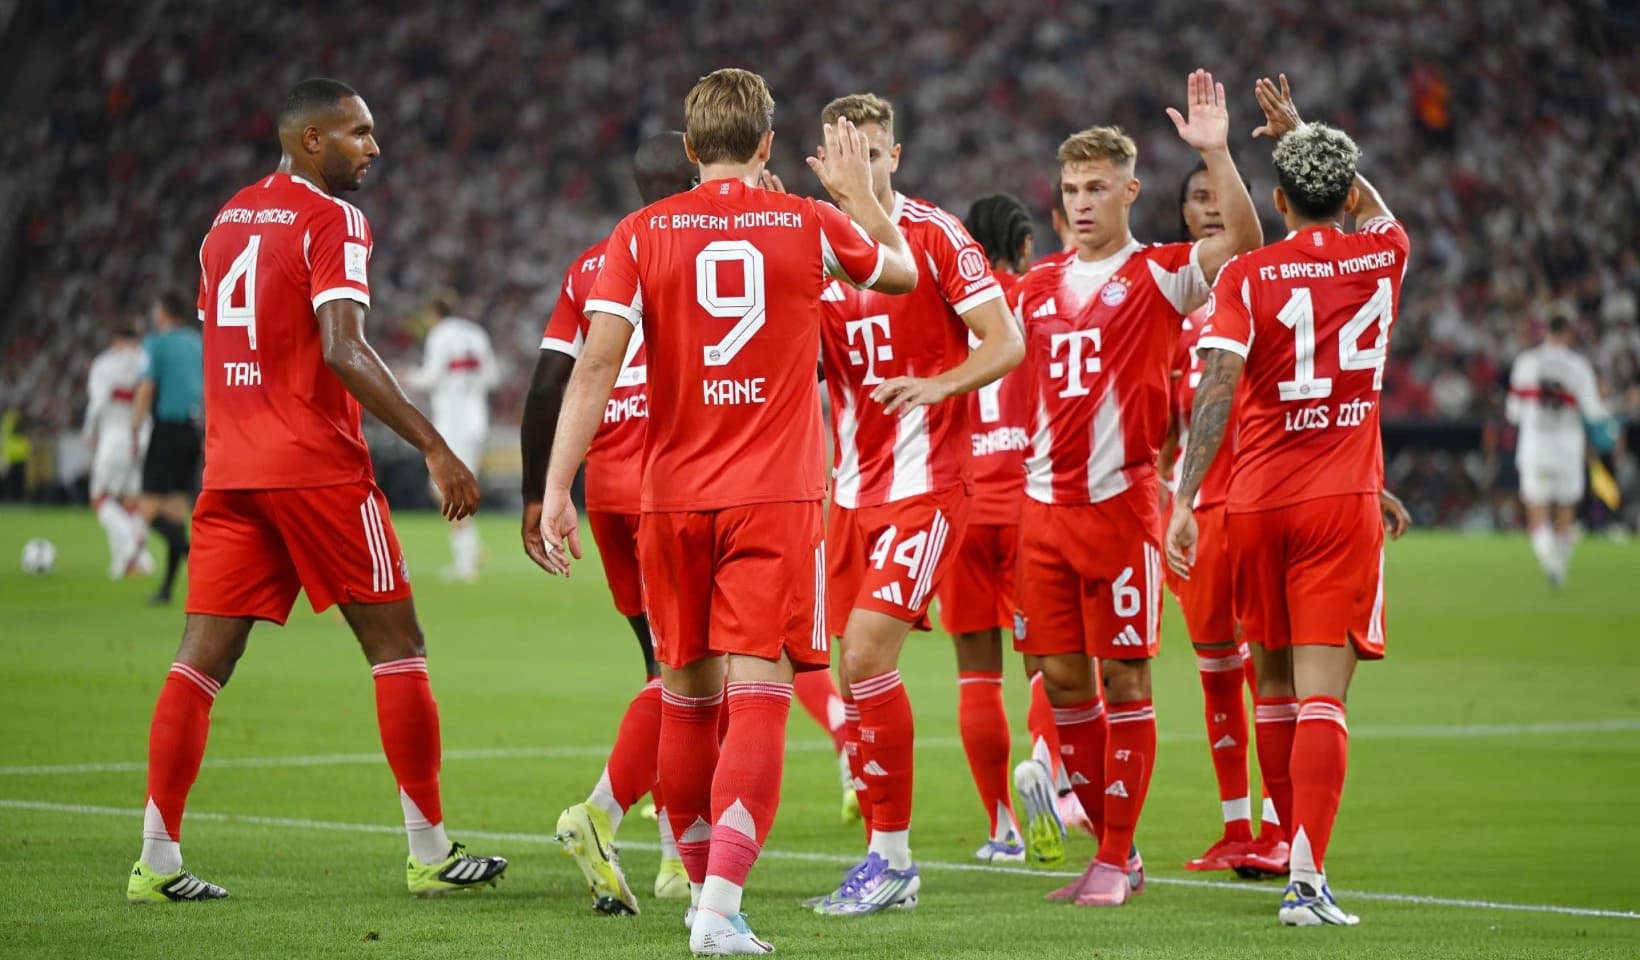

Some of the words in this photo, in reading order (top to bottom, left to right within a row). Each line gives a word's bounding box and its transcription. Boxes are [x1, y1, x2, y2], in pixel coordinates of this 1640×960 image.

[650, 215, 667, 229] FC
[672, 215, 728, 231] BAYERN
[581, 257, 598, 273] FC
[1259, 267, 1277, 281] FC
[1280, 262, 1334, 279] BAYERN
[216, 234, 262, 350] 4
[696, 240, 766, 366] 9
[1276, 277, 1393, 402] 14
[224, 362, 262, 387] TAH
[703, 377, 766, 406] KANE
[1285, 405, 1330, 431] LUIS
[1336, 398, 1375, 426] DÍ
[869, 524, 928, 580] 44
[1112, 567, 1141, 617] 6
